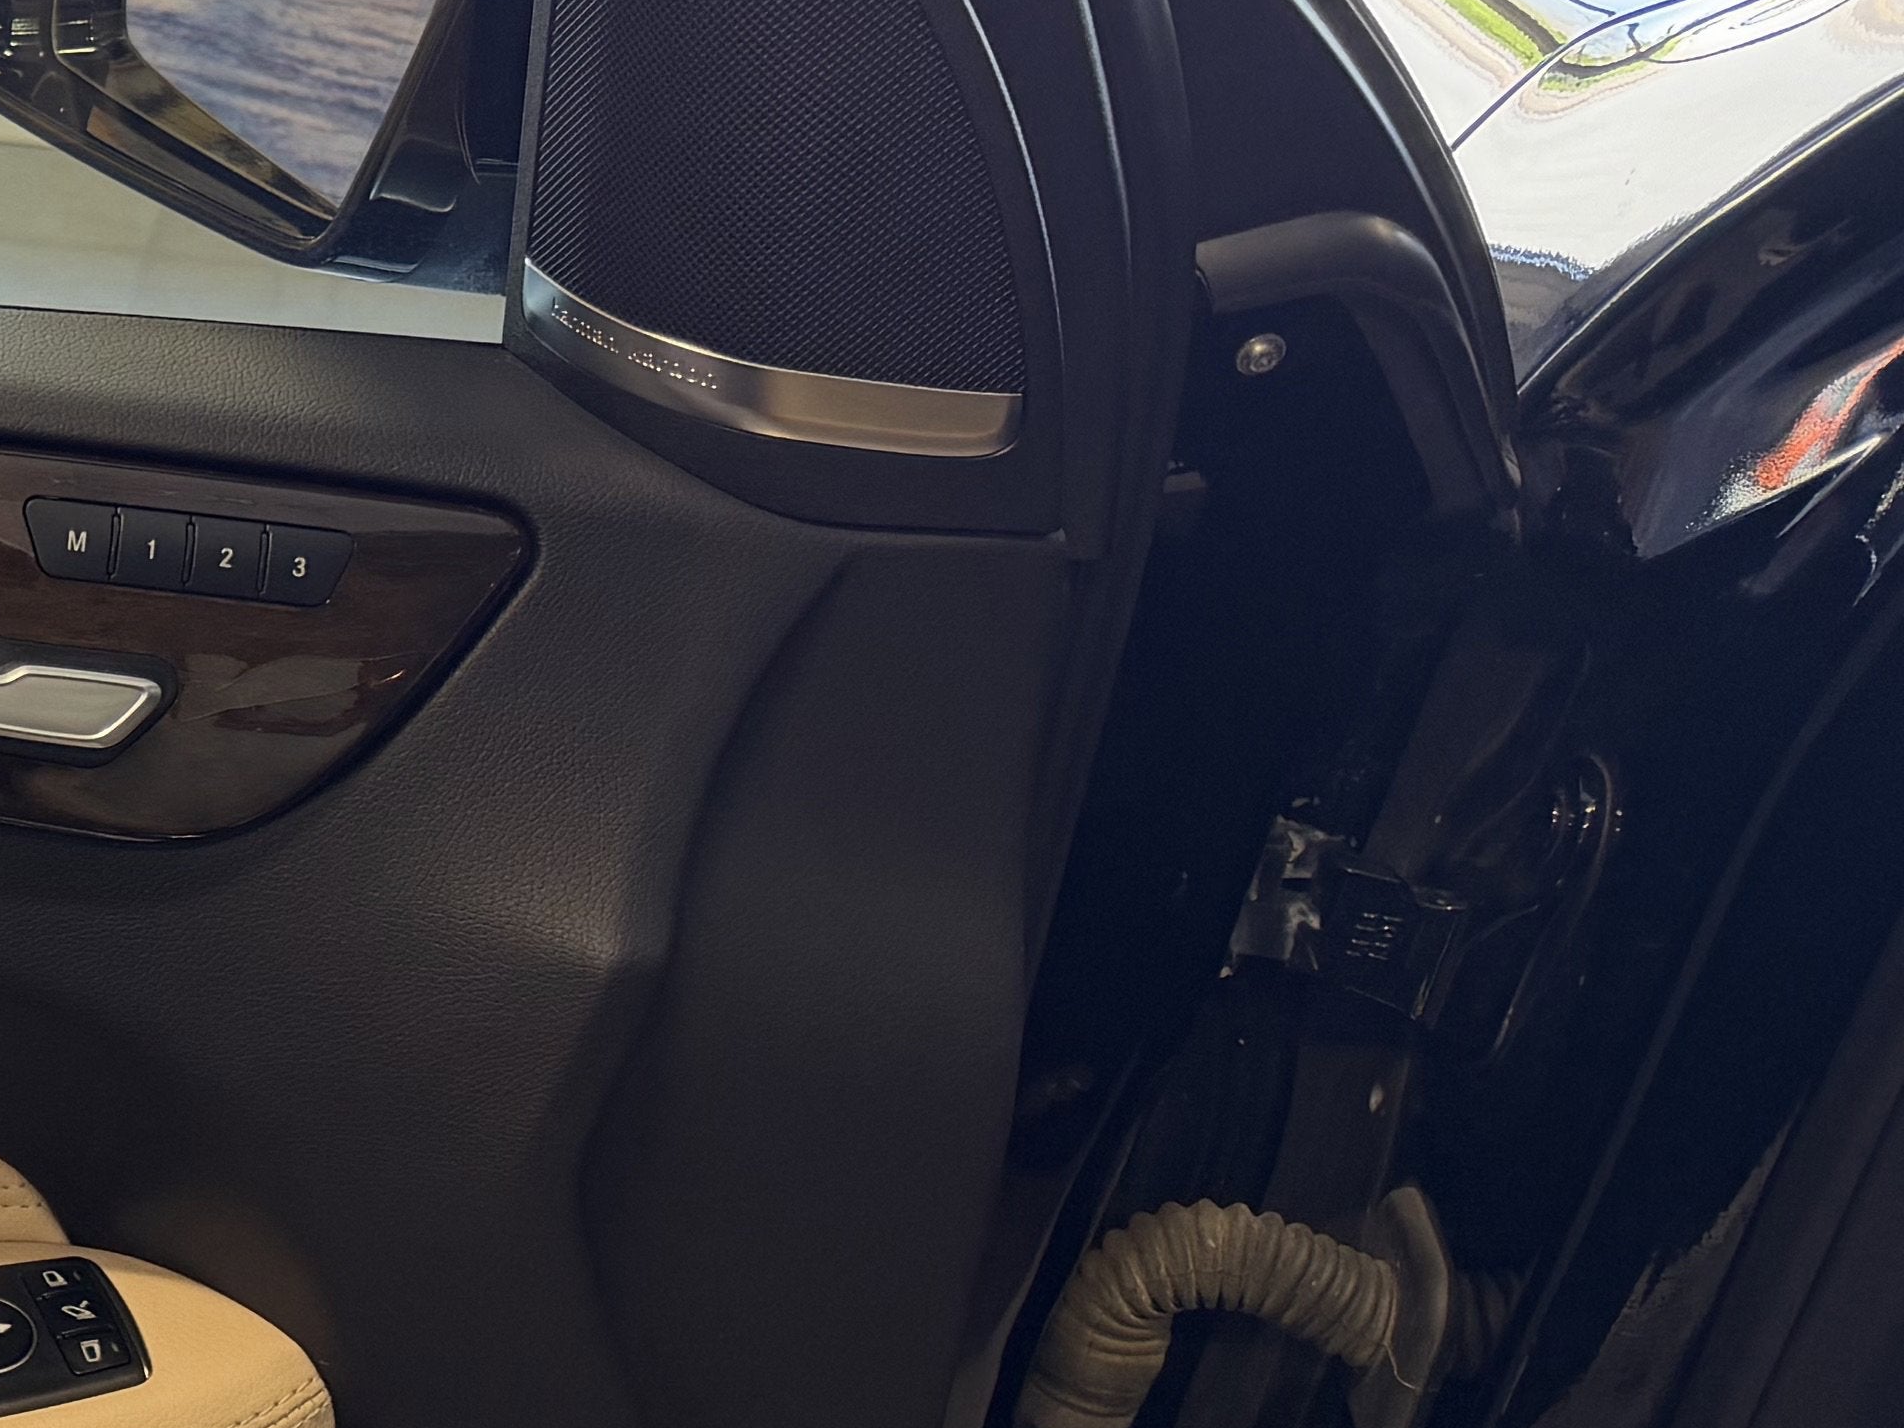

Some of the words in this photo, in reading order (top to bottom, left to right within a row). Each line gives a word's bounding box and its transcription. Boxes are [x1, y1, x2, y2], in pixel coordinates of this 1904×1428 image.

[66, 530, 88, 553] M
[146, 539, 157, 560] 1
[219, 547, 234, 569] 2
[292, 556, 307, 578] 3
